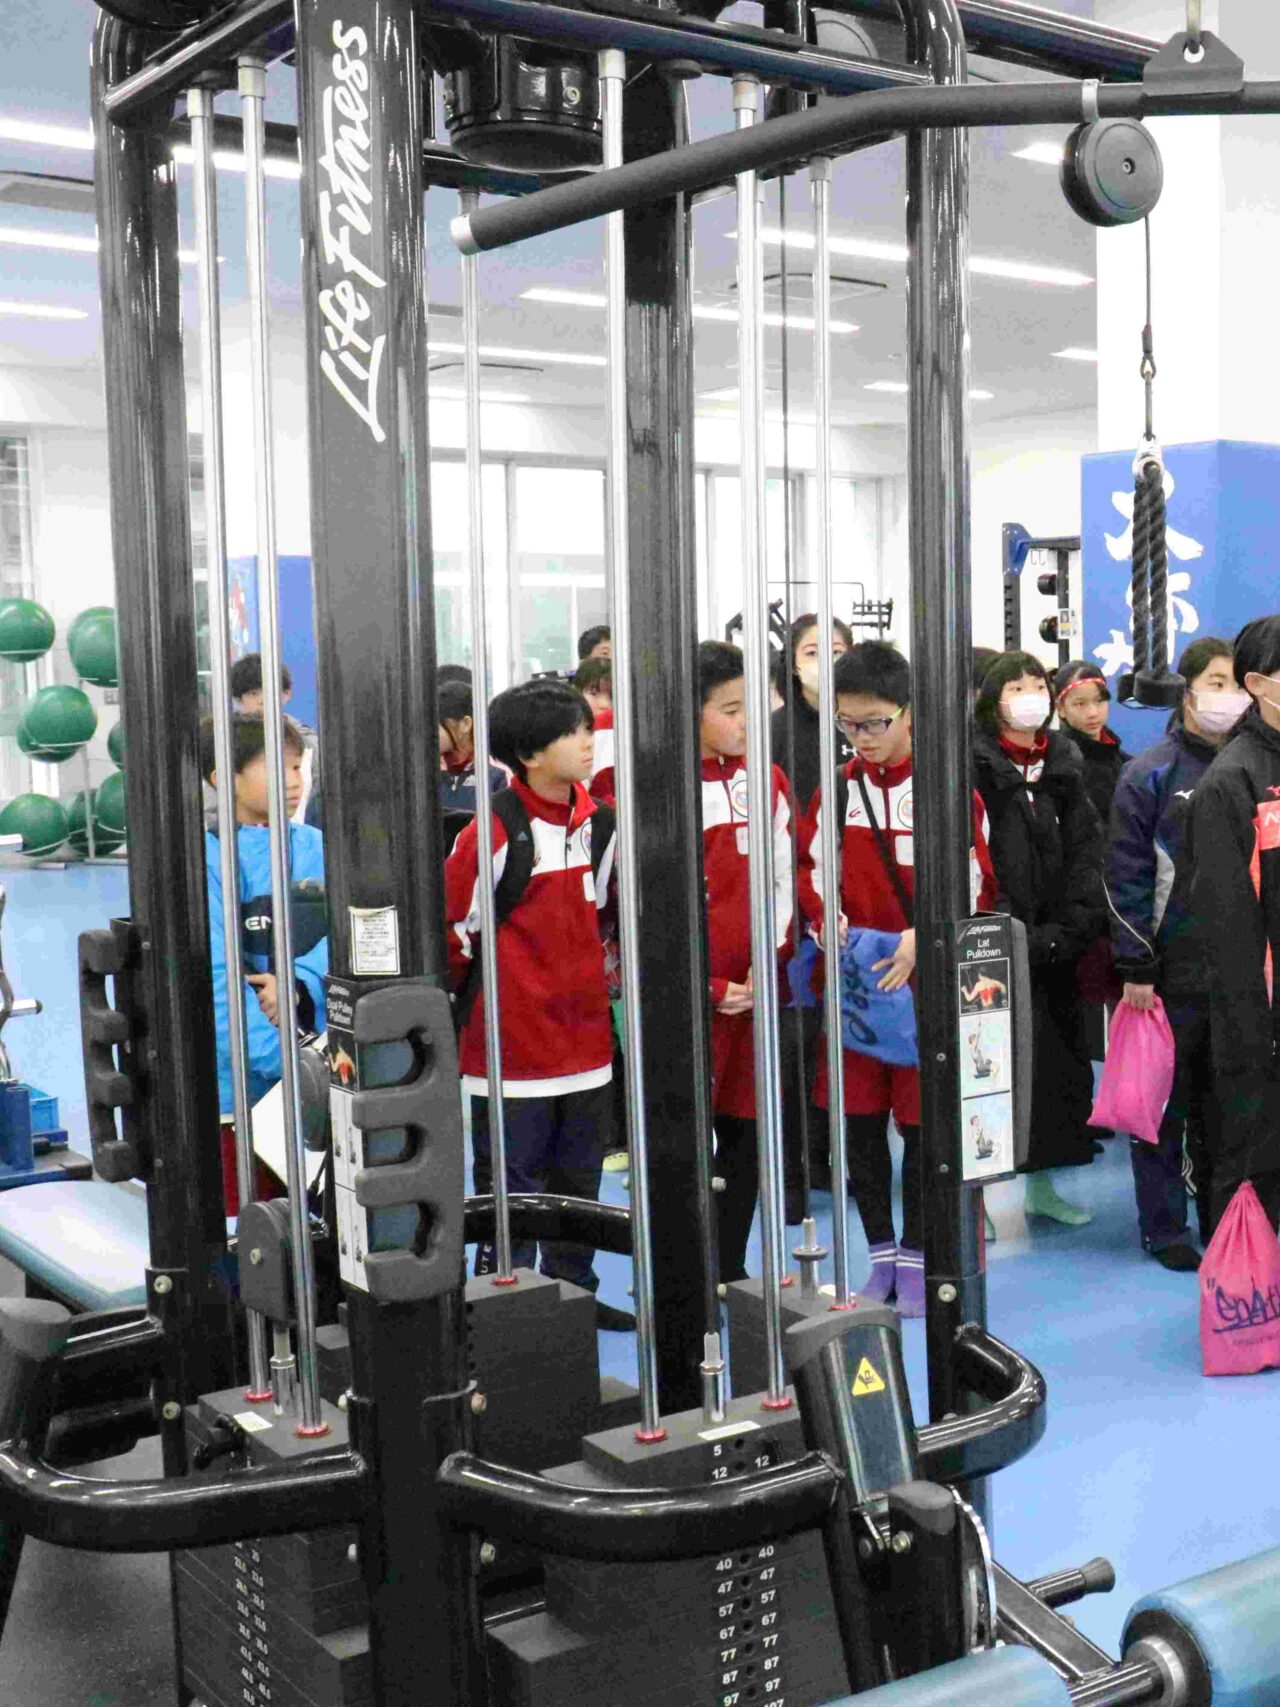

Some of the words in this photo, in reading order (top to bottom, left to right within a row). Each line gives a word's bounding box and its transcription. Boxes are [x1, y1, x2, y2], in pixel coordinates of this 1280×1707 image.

[318, 18, 388, 289] Fitness
[319, 279, 387, 444] Life
[966, 948, 1001, 960] Pulldown
[713, 1444, 722, 1457] 5
[711, 1466, 728, 1480] 12
[754, 1454, 770, 1469] 12
[715, 1557, 733, 1572] 40
[758, 1544, 774, 1559] 40
[717, 1580, 733, 1595] 47
[759, 1567, 776, 1581] 47
[718, 1602, 735, 1618] 57
[760, 1588, 777, 1605] 57
[719, 1625, 736, 1640] 67
[761, 1611, 778, 1627] 67
[720, 1647, 737, 1663] 77
[762, 1633, 779, 1649] 77
[722, 1669, 739, 1685] 87
[763, 1655, 780, 1671] 87
[723, 1691, 740, 1707] 97
[764, 1677, 781, 1693] 97
